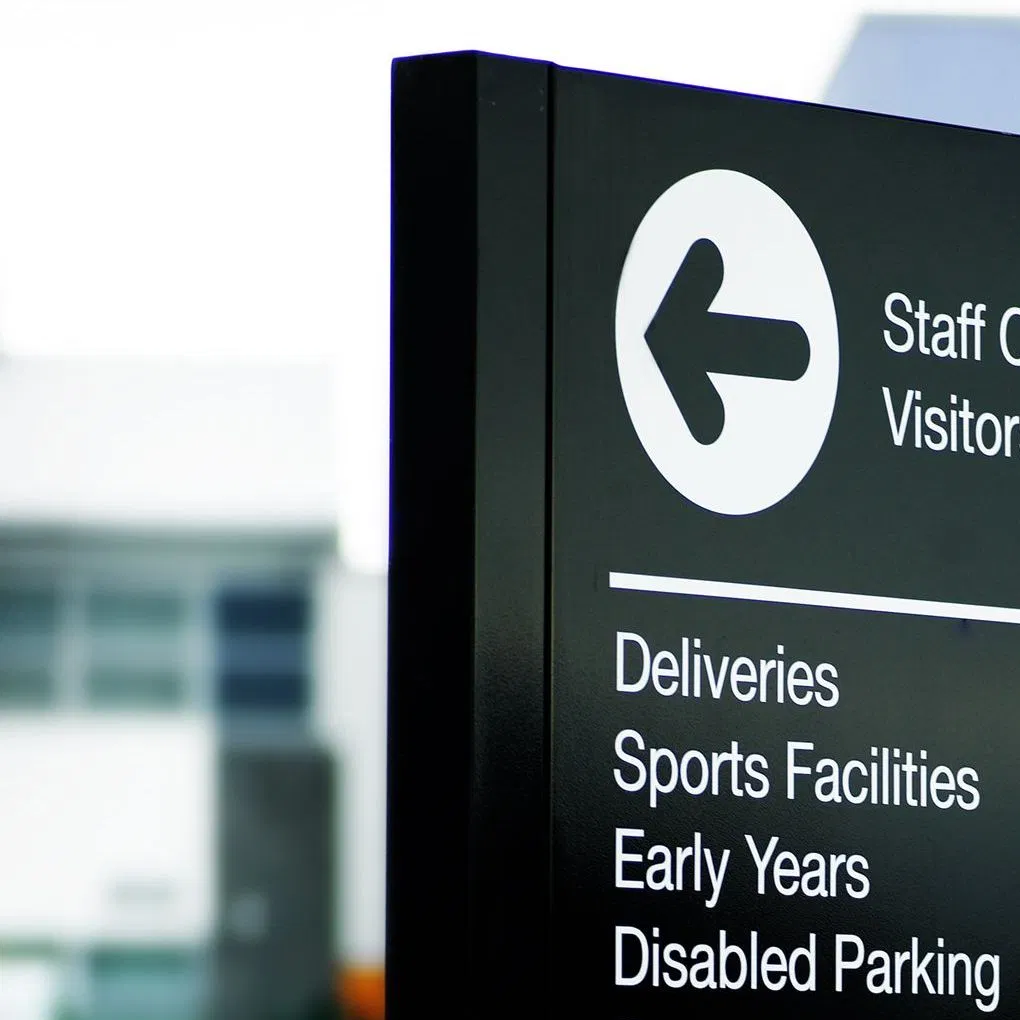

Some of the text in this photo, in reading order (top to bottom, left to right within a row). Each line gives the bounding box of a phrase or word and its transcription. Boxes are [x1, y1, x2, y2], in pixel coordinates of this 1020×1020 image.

[883, 292, 987, 361] Staff
[616, 631, 840, 708] Deliveries
[613, 728, 981, 811] Sports Facilities
[615, 827, 870, 909] Early Years
[615, 925, 1000, 1013] Disabled Parking
